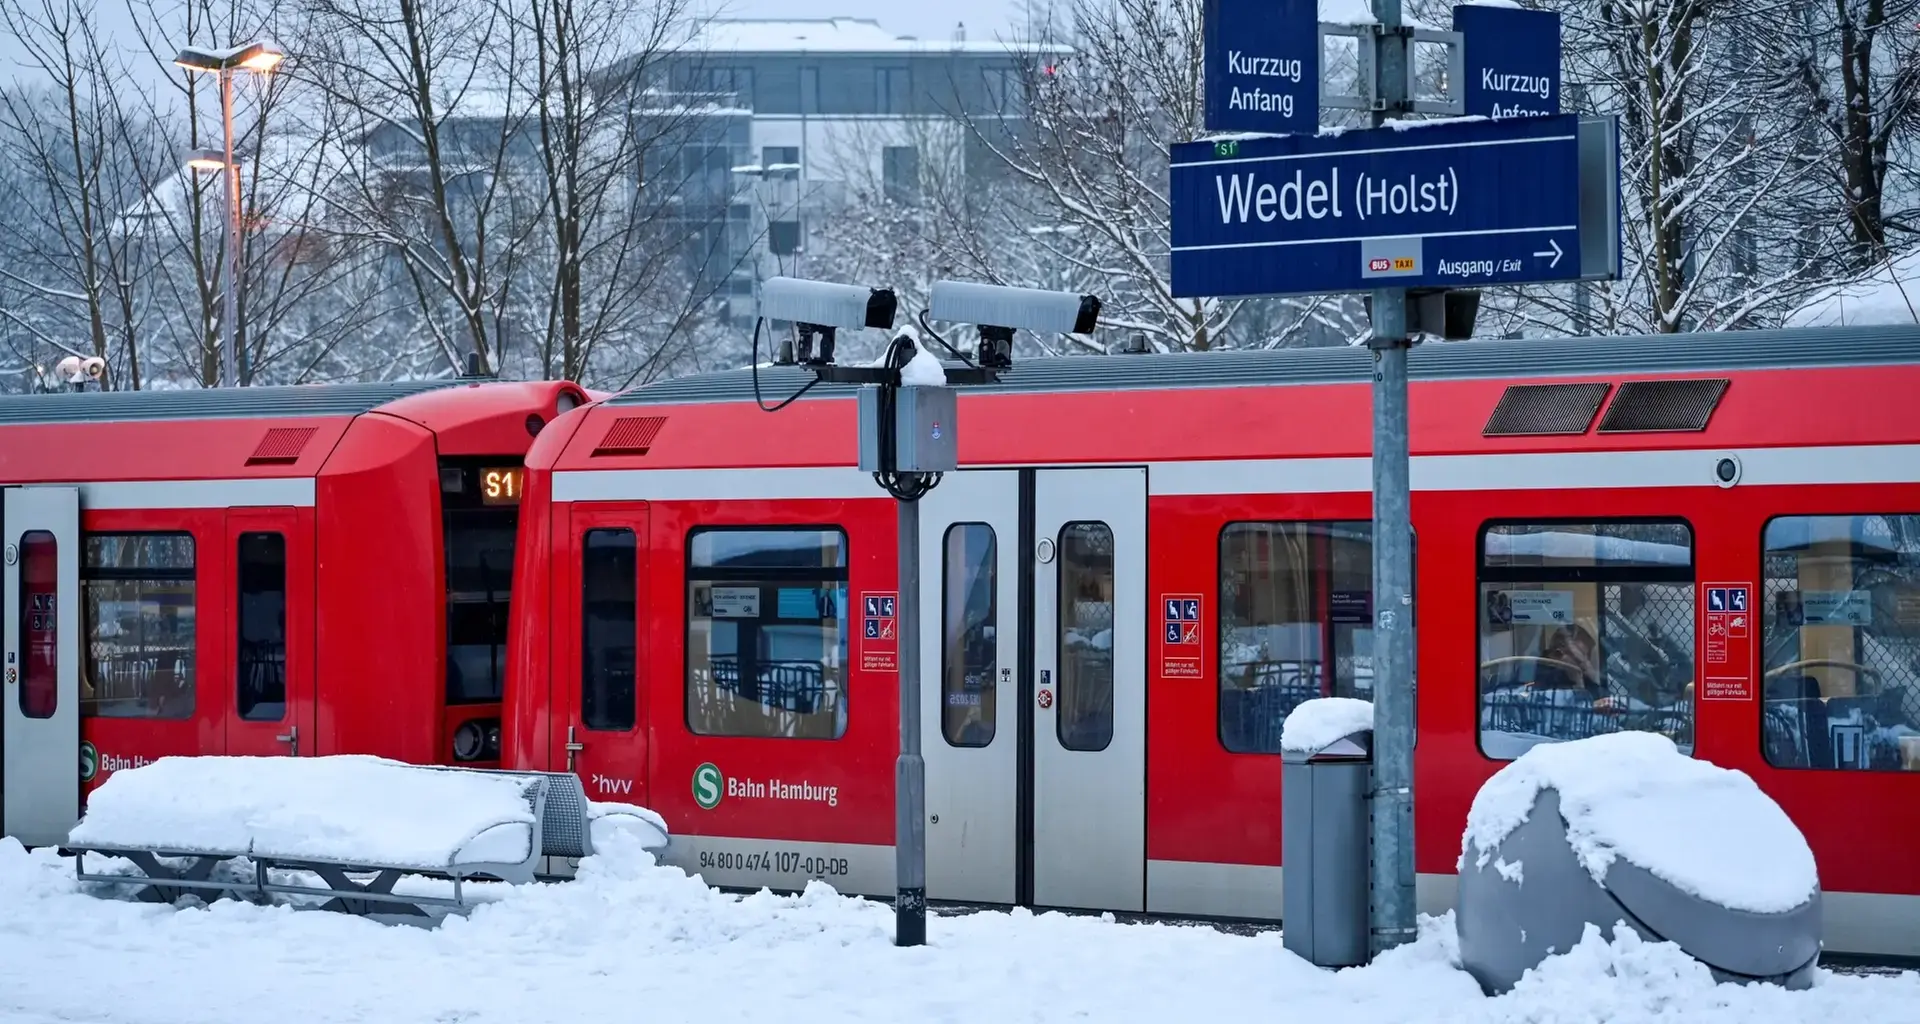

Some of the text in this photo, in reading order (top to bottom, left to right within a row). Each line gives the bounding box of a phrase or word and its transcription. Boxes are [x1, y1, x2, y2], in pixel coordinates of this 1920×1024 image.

[1228, 50, 1301, 83] Kurzzug
[1482, 67, 1550, 99] Kurzzug
[1228, 86, 1294, 118] Anfang
[1215, 166, 1458, 224] Wedel (Holst)
[1372, 259, 1413, 270] BUS TAXI
[1437, 258, 1494, 278] Ausgang
[1502, 259, 1522, 272] Exit
[486, 471, 513, 497] S1
[101, 753, 131, 771] Bahn
[728, 777, 765, 798] Bahn
[769, 779, 838, 807] Hamburg
[700, 851, 715, 868] 94
[717, 852, 733, 869] 80
[774, 851, 813, 874] 107-0
[816, 857, 848, 877] D-DB
